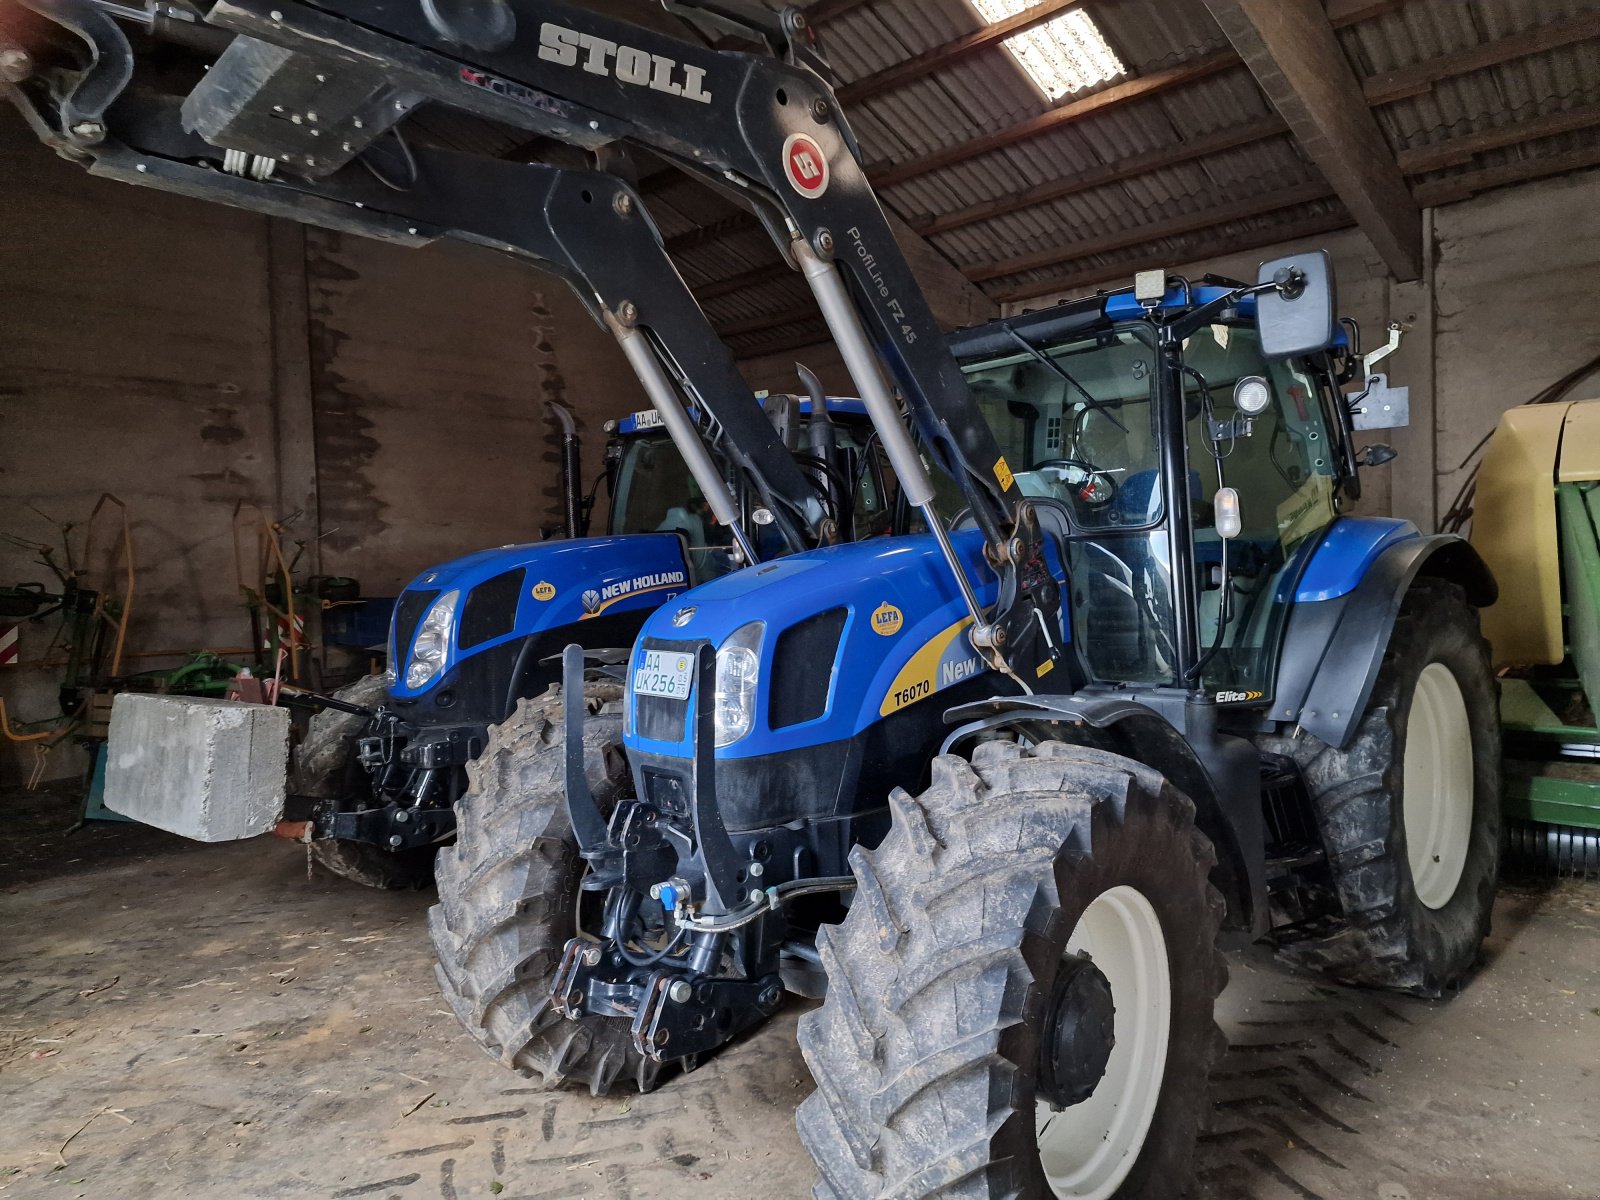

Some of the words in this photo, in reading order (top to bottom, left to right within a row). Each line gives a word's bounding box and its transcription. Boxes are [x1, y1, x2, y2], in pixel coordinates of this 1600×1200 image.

[537, 22, 712, 104] STOLL
[847, 226, 889, 297] ProfiLine
[886, 298, 905, 323] FZ
[901, 325, 917, 344] 45
[637, 413, 646, 427] AA
[535, 586, 552, 594] LEFA
[601, 579, 631, 600] NEW
[633, 571, 684, 589] HOLLAND
[876, 610, 899, 624] LEFA
[645, 653, 660, 672] AA
[942, 656, 976, 685] New
[636, 672, 651, 691] UK
[651, 673, 676, 693] 256
[894, 679, 930, 706] T6070
[1216, 690, 1247, 703] Elite
